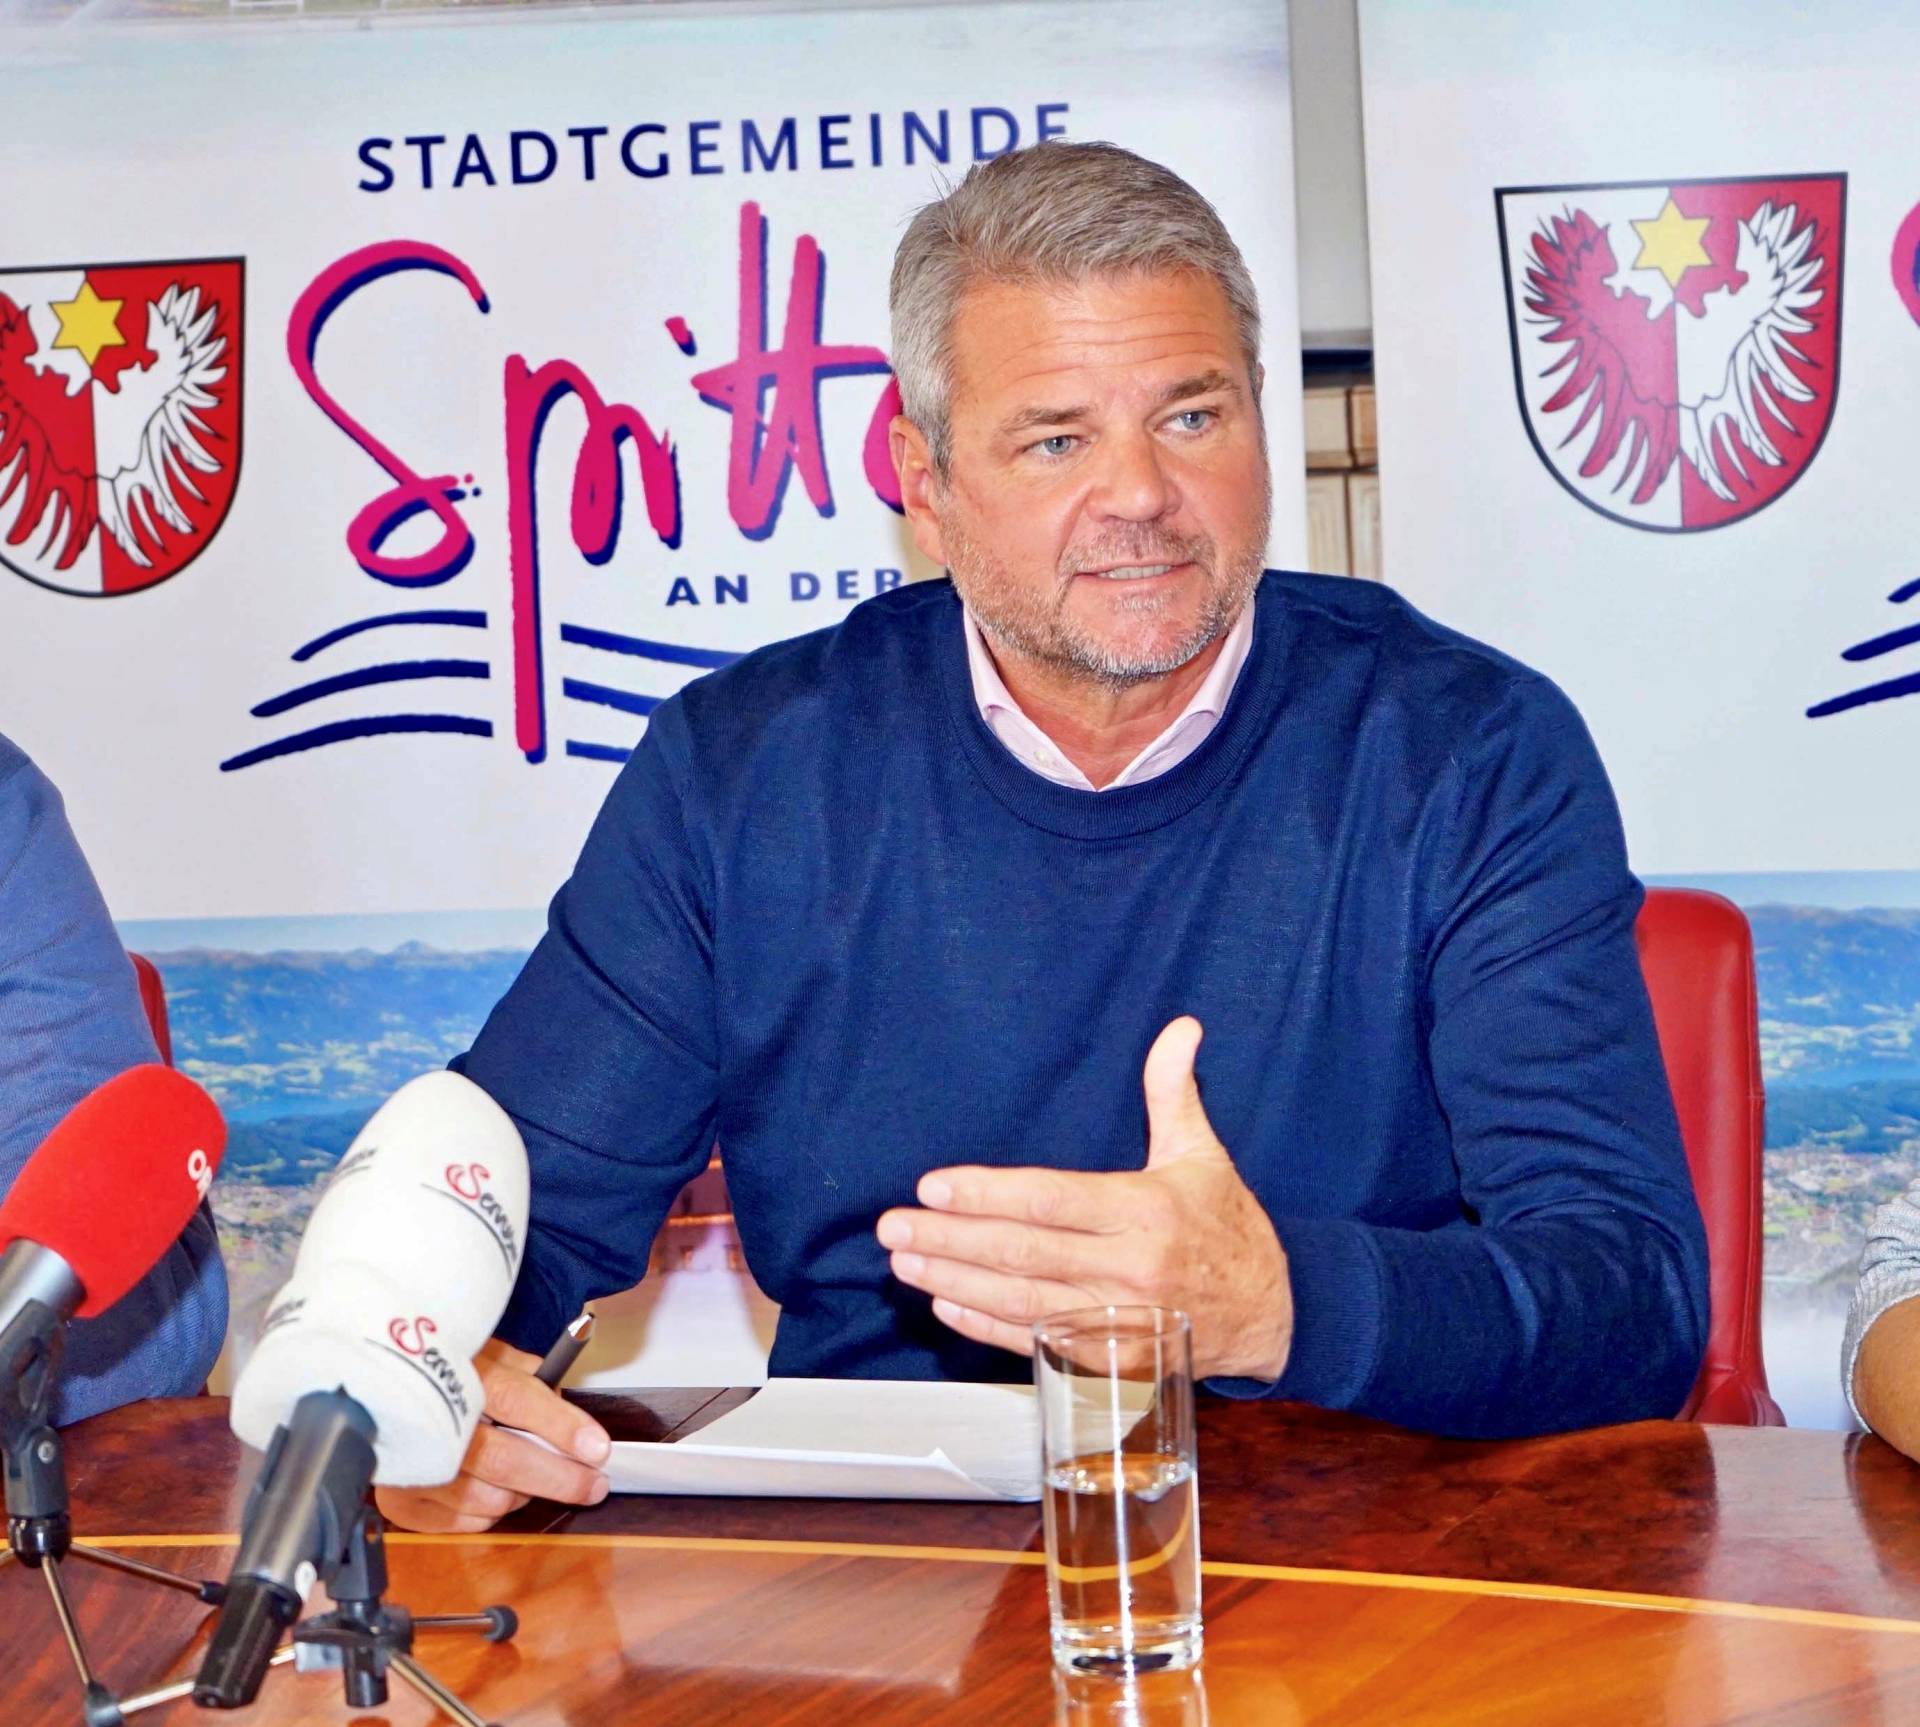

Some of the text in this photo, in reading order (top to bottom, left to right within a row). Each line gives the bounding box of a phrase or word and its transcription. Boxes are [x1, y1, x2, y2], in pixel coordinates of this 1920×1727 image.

[357, 103, 1069, 193] STADTGEMEINDE
[665, 568, 903, 606] AN DER
